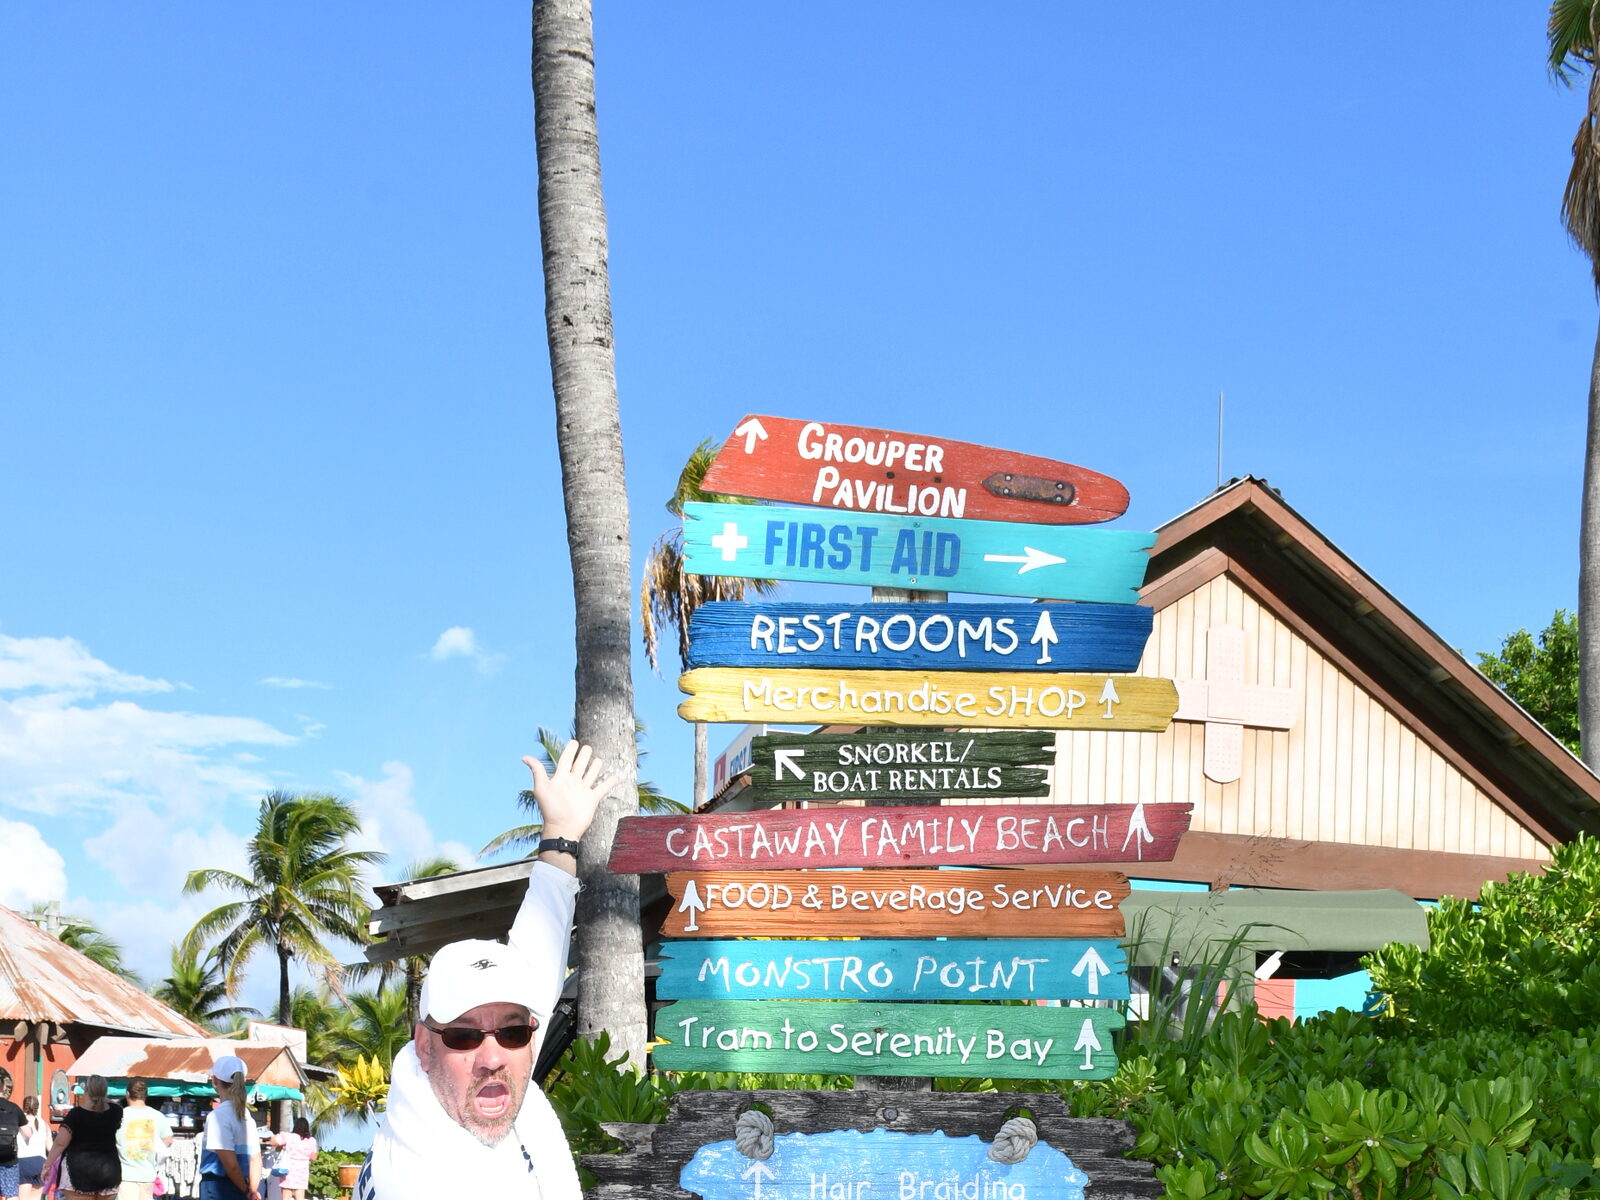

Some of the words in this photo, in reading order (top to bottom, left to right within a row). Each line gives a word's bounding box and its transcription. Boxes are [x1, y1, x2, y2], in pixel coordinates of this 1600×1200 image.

[797, 421, 945, 473] GROUPER
[813, 465, 967, 518] PAVILION
[765, 521, 878, 571] FIRST
[891, 531, 961, 577] AID
[751, 613, 1018, 657] RESTROOMS
[743, 677, 976, 717] Merchandise
[984, 686, 1086, 718] SHOP
[838, 739, 975, 765] SNORKEL/
[813, 770, 887, 792] BOAT
[889, 767, 1002, 790] RENTALS
[666, 819, 849, 861] CASTAWAY
[861, 816, 983, 856] FAMILY
[996, 815, 1109, 852] BEACH
[706, 883, 793, 909] FOOD
[802, 885, 823, 909] &
[698, 956, 893, 992] MONSTRO
[914, 956, 1049, 992] POINT
[678, 1015, 773, 1050] Tram
[780, 1017, 818, 1051] to
[827, 1024, 977, 1064] Serenity
[986, 1029, 1054, 1065] Bay
[808, 1172, 871, 1200] Hair
